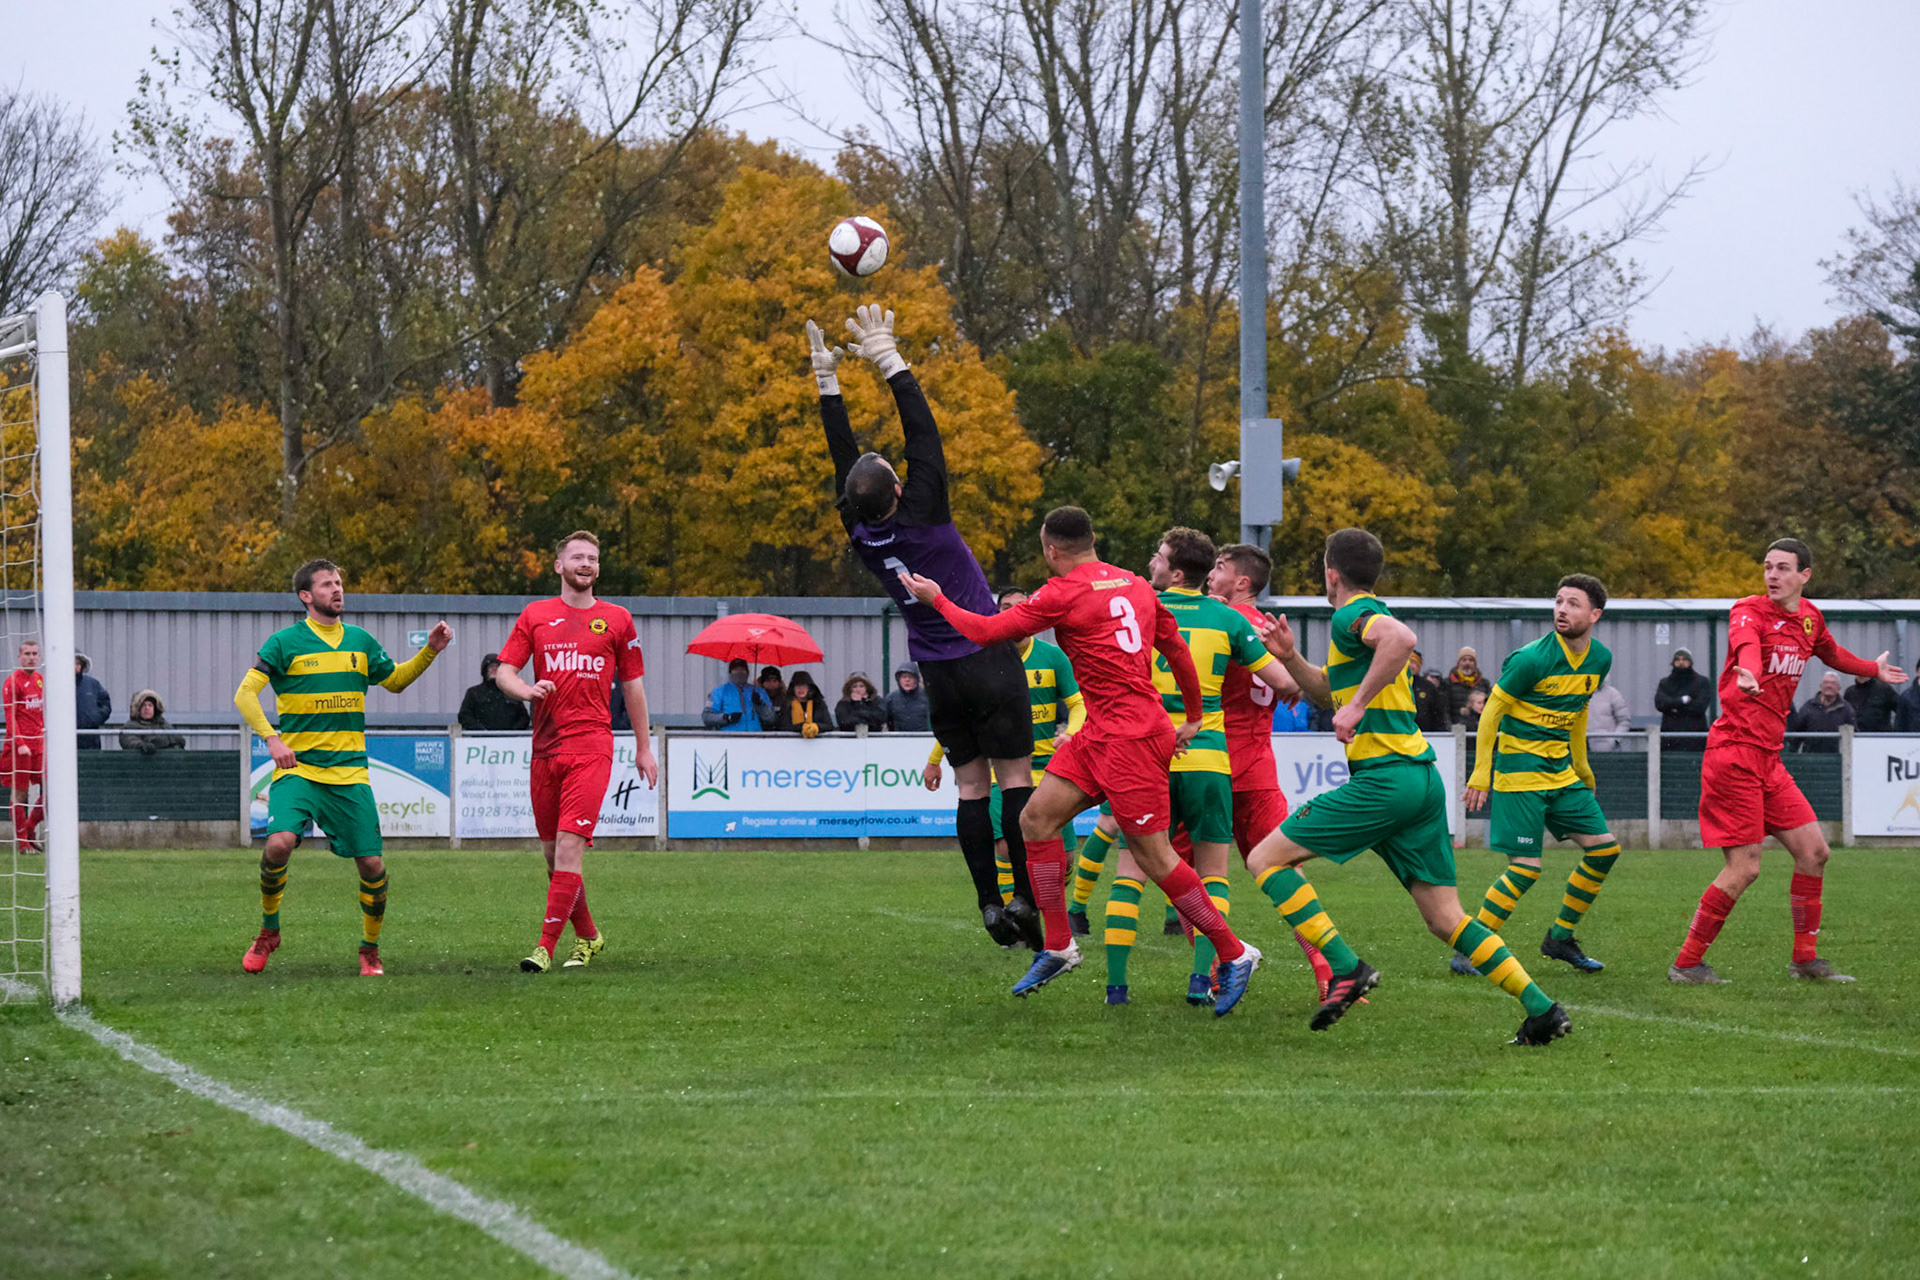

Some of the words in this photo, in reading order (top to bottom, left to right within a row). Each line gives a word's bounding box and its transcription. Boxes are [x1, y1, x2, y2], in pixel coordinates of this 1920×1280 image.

[883, 556, 919, 605] 1
[1109, 596, 1142, 654] 3
[543, 642, 578, 651] STEWART
[544, 650, 605, 672] Milne
[1768, 652, 1806, 675] Miln
[576, 672, 600, 680] HOMES
[466, 746, 515, 765] Plan
[1294, 754, 1349, 794] yie
[1887, 755, 1920, 782] RU
[461, 779, 494, 788] Holiday
[496, 779, 511, 787] Inn
[742, 764, 924, 793] merseyflow
[461, 791, 486, 799] Wood
[377, 796, 436, 819] ecycle
[461, 806, 501, 817] 01928
[505, 806, 534, 817] 7548
[597, 814, 637, 826] Holiday
[637, 813, 655, 824] Inn
[742, 816, 778, 828] Register
[780, 816, 807, 825] online
[808, 816, 817, 825] at
[818, 815, 919, 827] merseyflow.co.uk
[921, 815, 934, 824] for
[461, 827, 537, 835] Events@HIRunco
[1517, 836, 1534, 844] 1895
